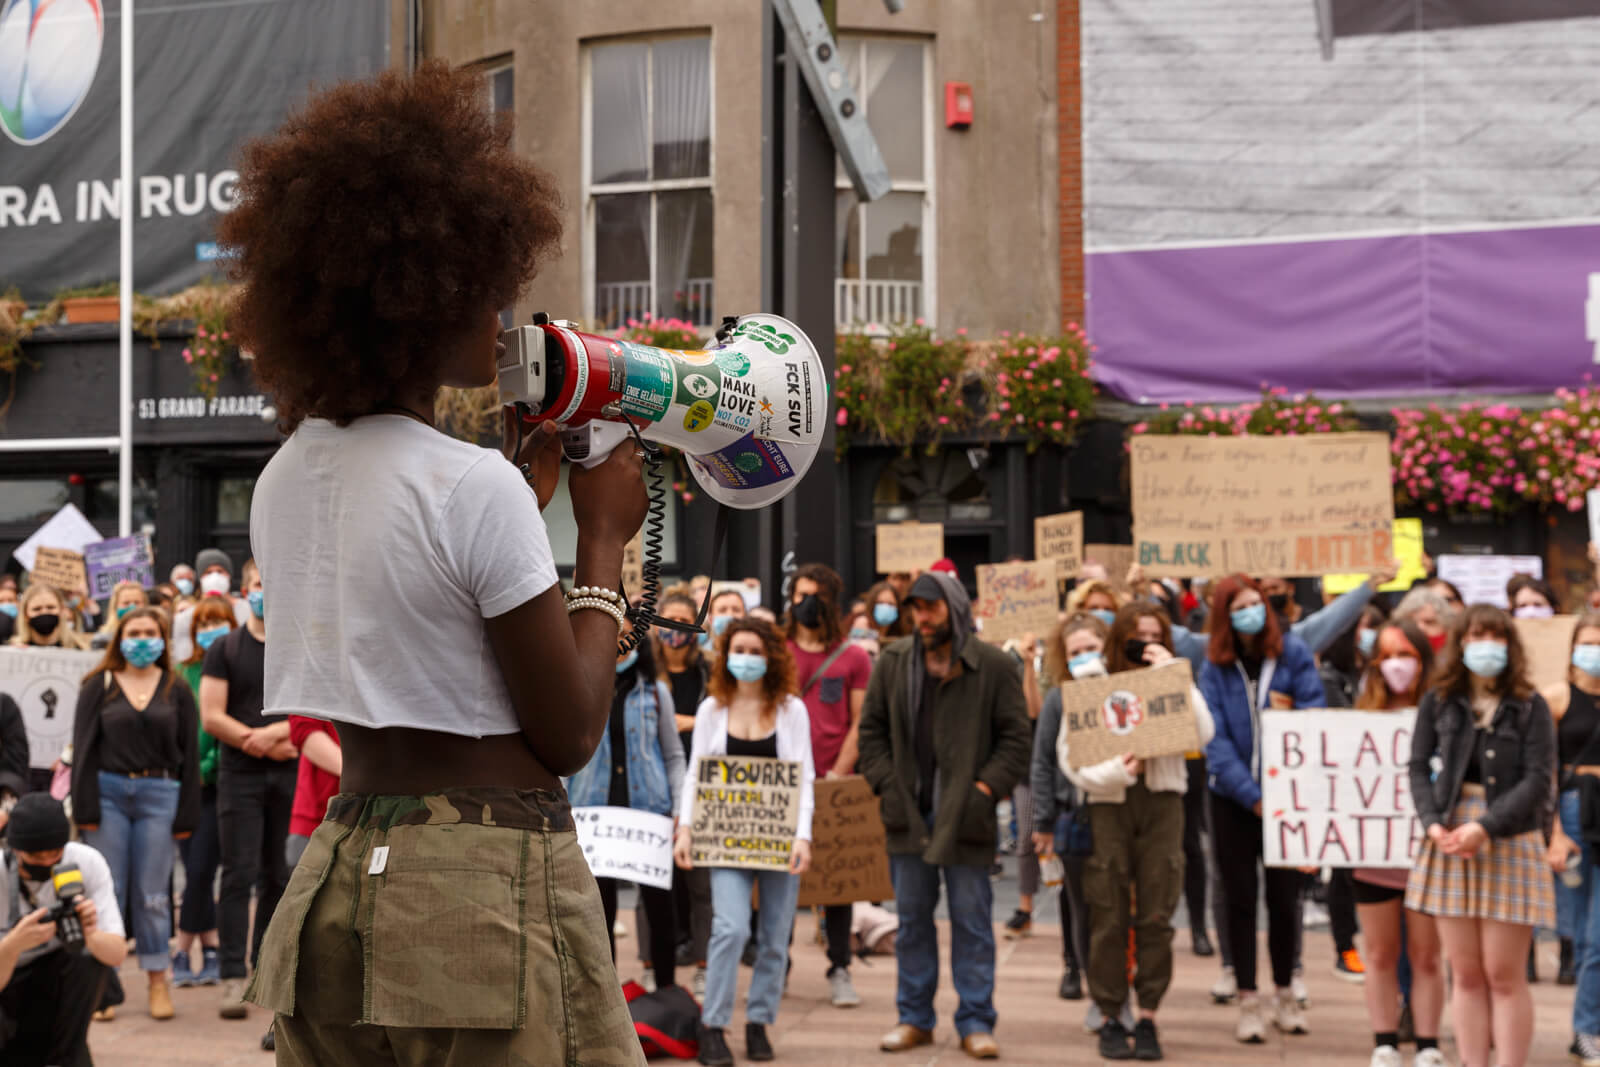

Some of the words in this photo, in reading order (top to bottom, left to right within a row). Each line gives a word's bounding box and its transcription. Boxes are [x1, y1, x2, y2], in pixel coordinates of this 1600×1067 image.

[76, 178, 122, 222] IN
[785, 362, 801, 396] FCK
[139, 398, 156, 419] 51
[158, 396, 206, 418] GRAND
[209, 395, 265, 417] PARADE
[721, 392, 756, 416] LOVE
[716, 409, 732, 421] NOT
[734, 415, 751, 427] CO2
[788, 399, 801, 437] SUV
[1138, 541, 1212, 567] BLACK
[1295, 529, 1393, 571] MATTER
[698, 760, 719, 784] IF
[761, 762, 799, 788] ARE
[696, 787, 765, 805] NEUTRAL
[770, 791, 790, 806] IN
[702, 803, 786, 821] SITUATIONS
[593, 824, 669, 849] LIBERTY
[591, 857, 669, 879] EQUALITY
